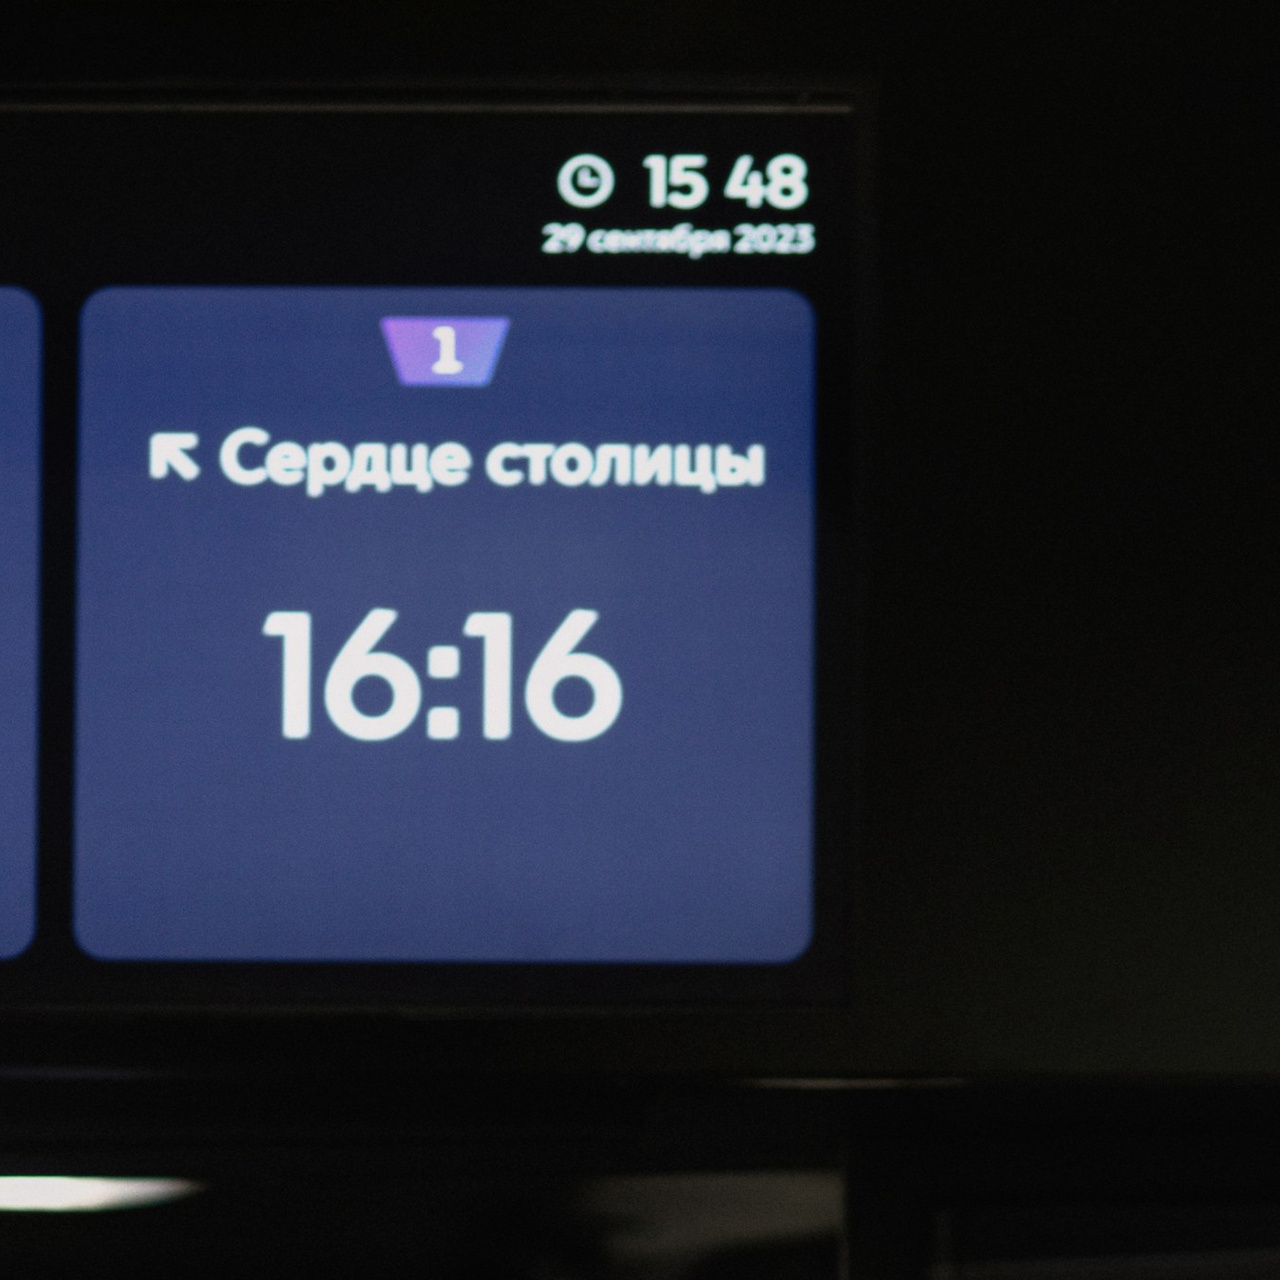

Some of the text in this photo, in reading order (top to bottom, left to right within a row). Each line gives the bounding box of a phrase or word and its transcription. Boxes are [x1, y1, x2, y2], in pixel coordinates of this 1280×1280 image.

[643, 153, 809, 210] 15 48
[541, 222, 815, 260] 29 сентября 2023
[431, 325, 464, 375] 1
[218, 426, 766, 498] Сердце столицы
[261, 607, 623, 742] 16:16
